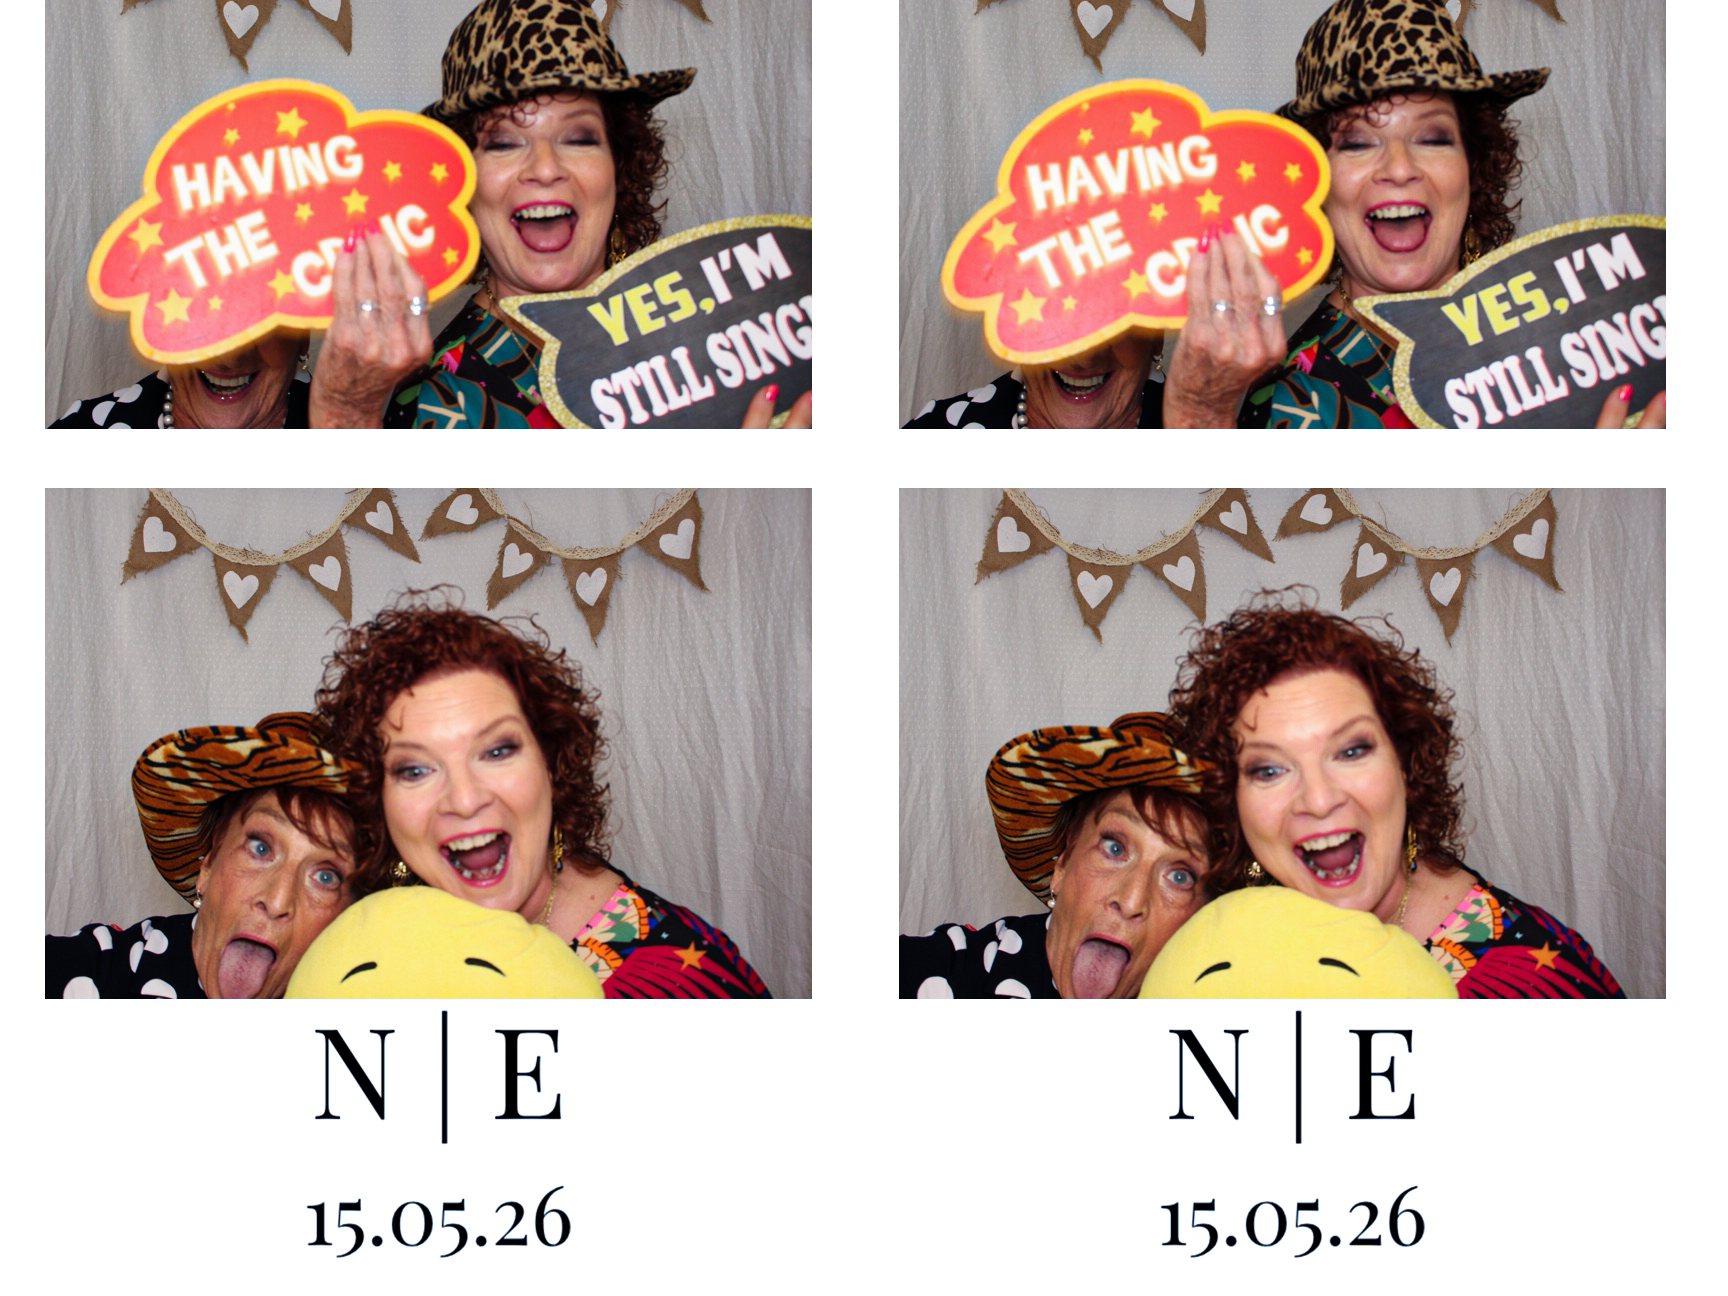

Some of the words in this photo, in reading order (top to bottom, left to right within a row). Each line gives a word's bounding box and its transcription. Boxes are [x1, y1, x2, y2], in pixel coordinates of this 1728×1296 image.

[171, 135, 364, 212] HAVING
[1025, 135, 1218, 212] HAVING
[163, 209, 280, 289] THE
[291, 204, 435, 298] CIC
[699, 232, 792, 304] I'M
[1017, 209, 1134, 289] THE
[1145, 204, 1289, 298] CIC
[1553, 232, 1646, 304] I'M
[590, 345, 715, 429] STILL
[706, 295, 812, 388] SING
[1444, 345, 1569, 429] STILL
[1560, 295, 1666, 388] SING
